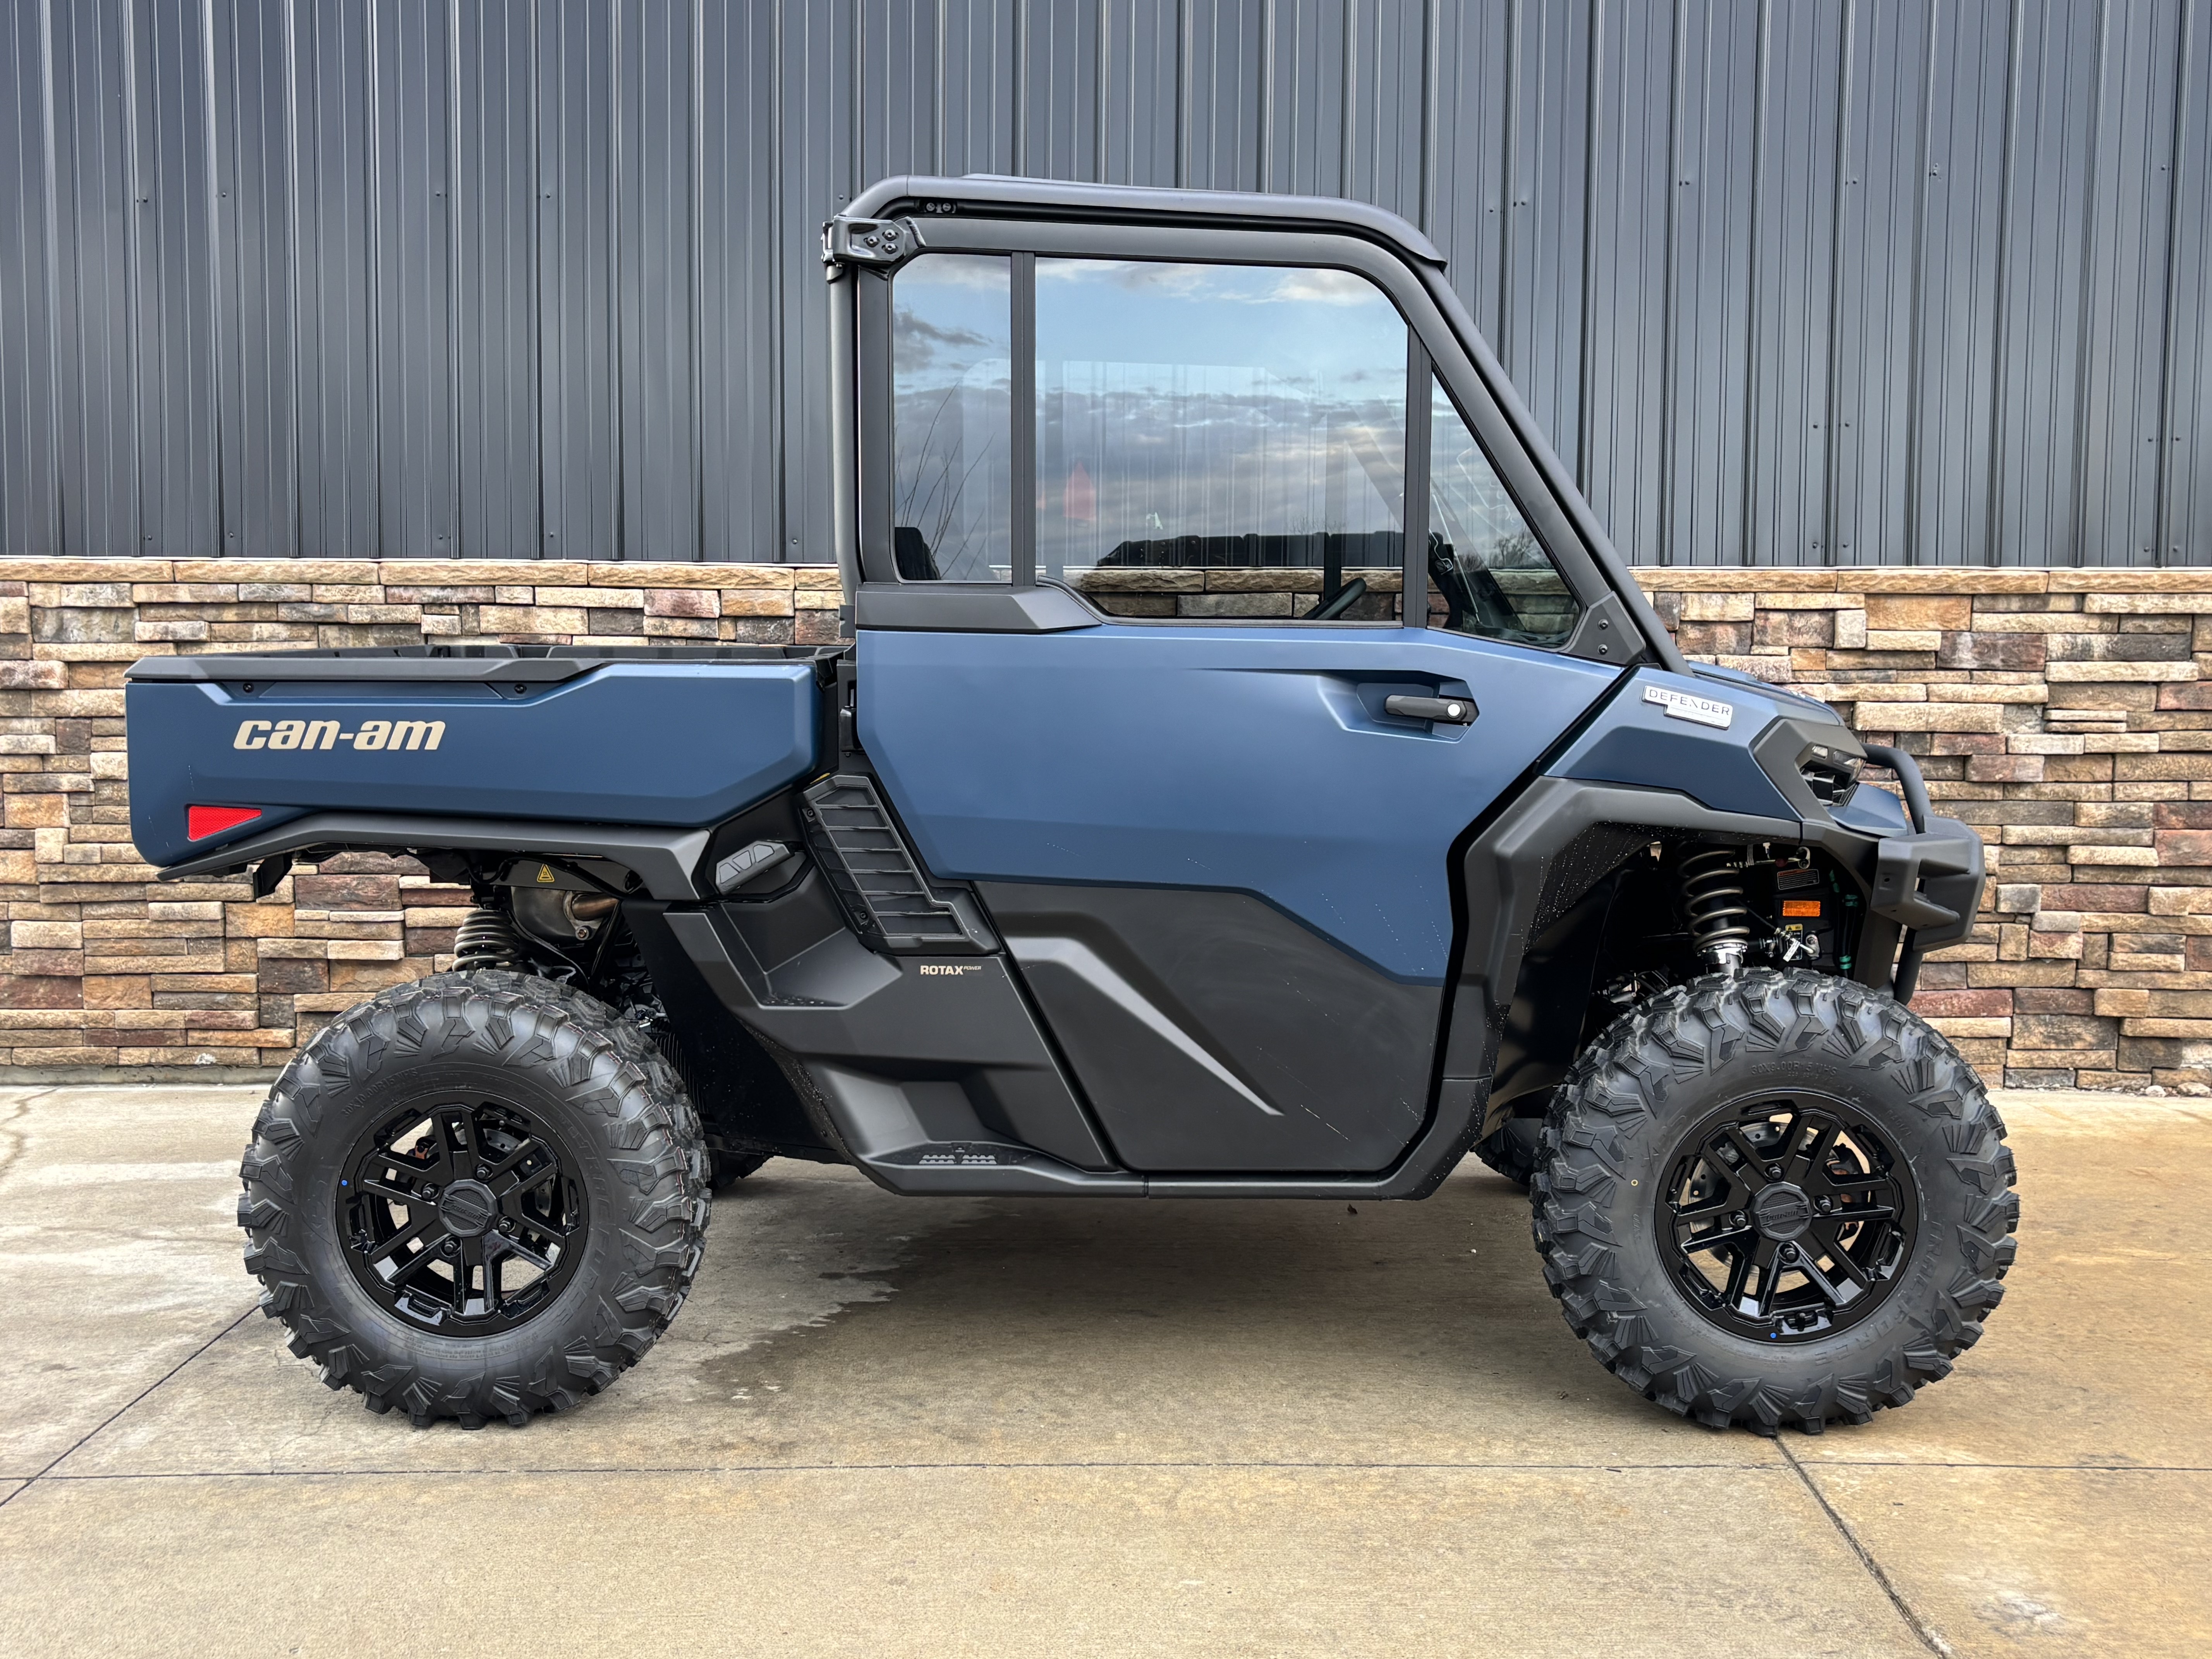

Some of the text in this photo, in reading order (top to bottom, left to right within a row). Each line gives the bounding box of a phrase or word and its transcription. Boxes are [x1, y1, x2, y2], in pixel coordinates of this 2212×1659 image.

[1649, 689, 1729, 715] DEFENDER
[233, 720, 446, 750] can-am
[920, 965, 963, 975] ROTAX
